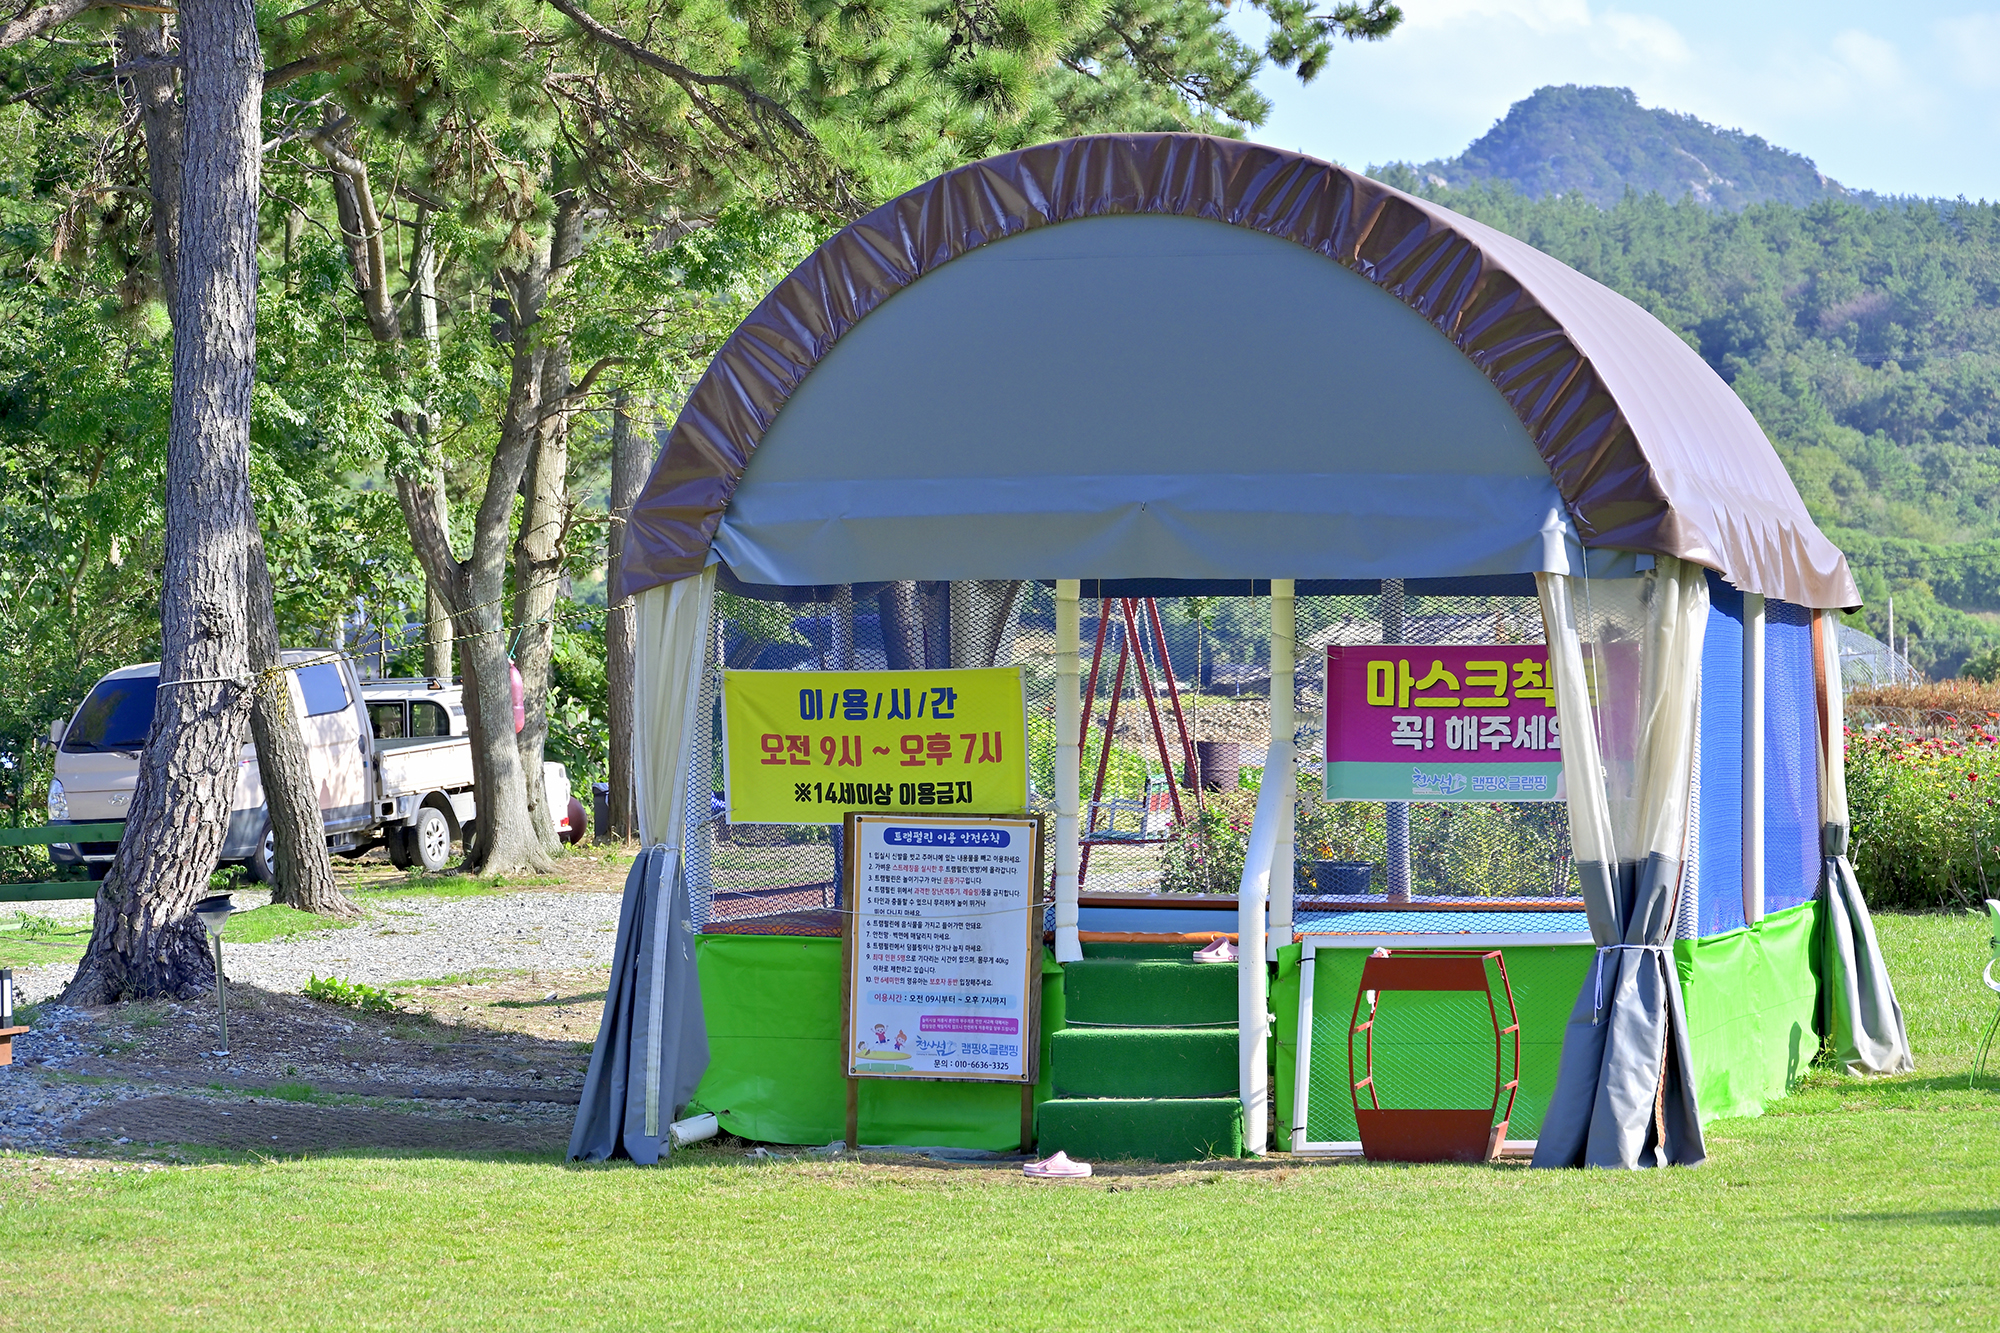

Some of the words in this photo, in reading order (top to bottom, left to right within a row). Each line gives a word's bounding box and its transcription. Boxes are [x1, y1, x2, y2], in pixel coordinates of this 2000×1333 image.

[1391, 715, 1434, 751] 꼭!
[760, 733, 811, 766] 오전
[820, 735, 863, 767] 9시
[900, 732, 953, 766] 오후
[959, 730, 1003, 765] 7시
[1412, 767, 1467, 795] 천사섬
[1472, 775, 1547, 792] 캠핑&글램핑
[899, 780, 973, 806] 이용금지
[937, 831, 956, 845] 이용
[960, 831, 1000, 845] 안전수칙
[892, 853, 908, 861] 신발을
[909, 853, 921, 861] 벗고
[945, 854, 955, 862] 있는
[931, 876, 942, 884] 아닌
[874, 897, 890, 905] 타인과
[916, 898, 932, 906] 있으니
[924, 921, 941, 929] 가지고
[941, 955, 957, 964] 시간이
[995, 957, 1009, 966] 40kg
[874, 993, 902, 1003] 이용시간
[909, 994, 923, 1004] 오전
[925, 995, 956, 1004] 09시부터
[964, 995, 979, 1004] 오후
[981, 996, 1007, 1006] 7시까지
[916, 1034, 957, 1057] 천사섬
[962, 1042, 1018, 1057] 캠핑&글램핑
[934, 1059, 948, 1069] 문의
[954, 1060, 1009, 1071] 010-6636-3325
